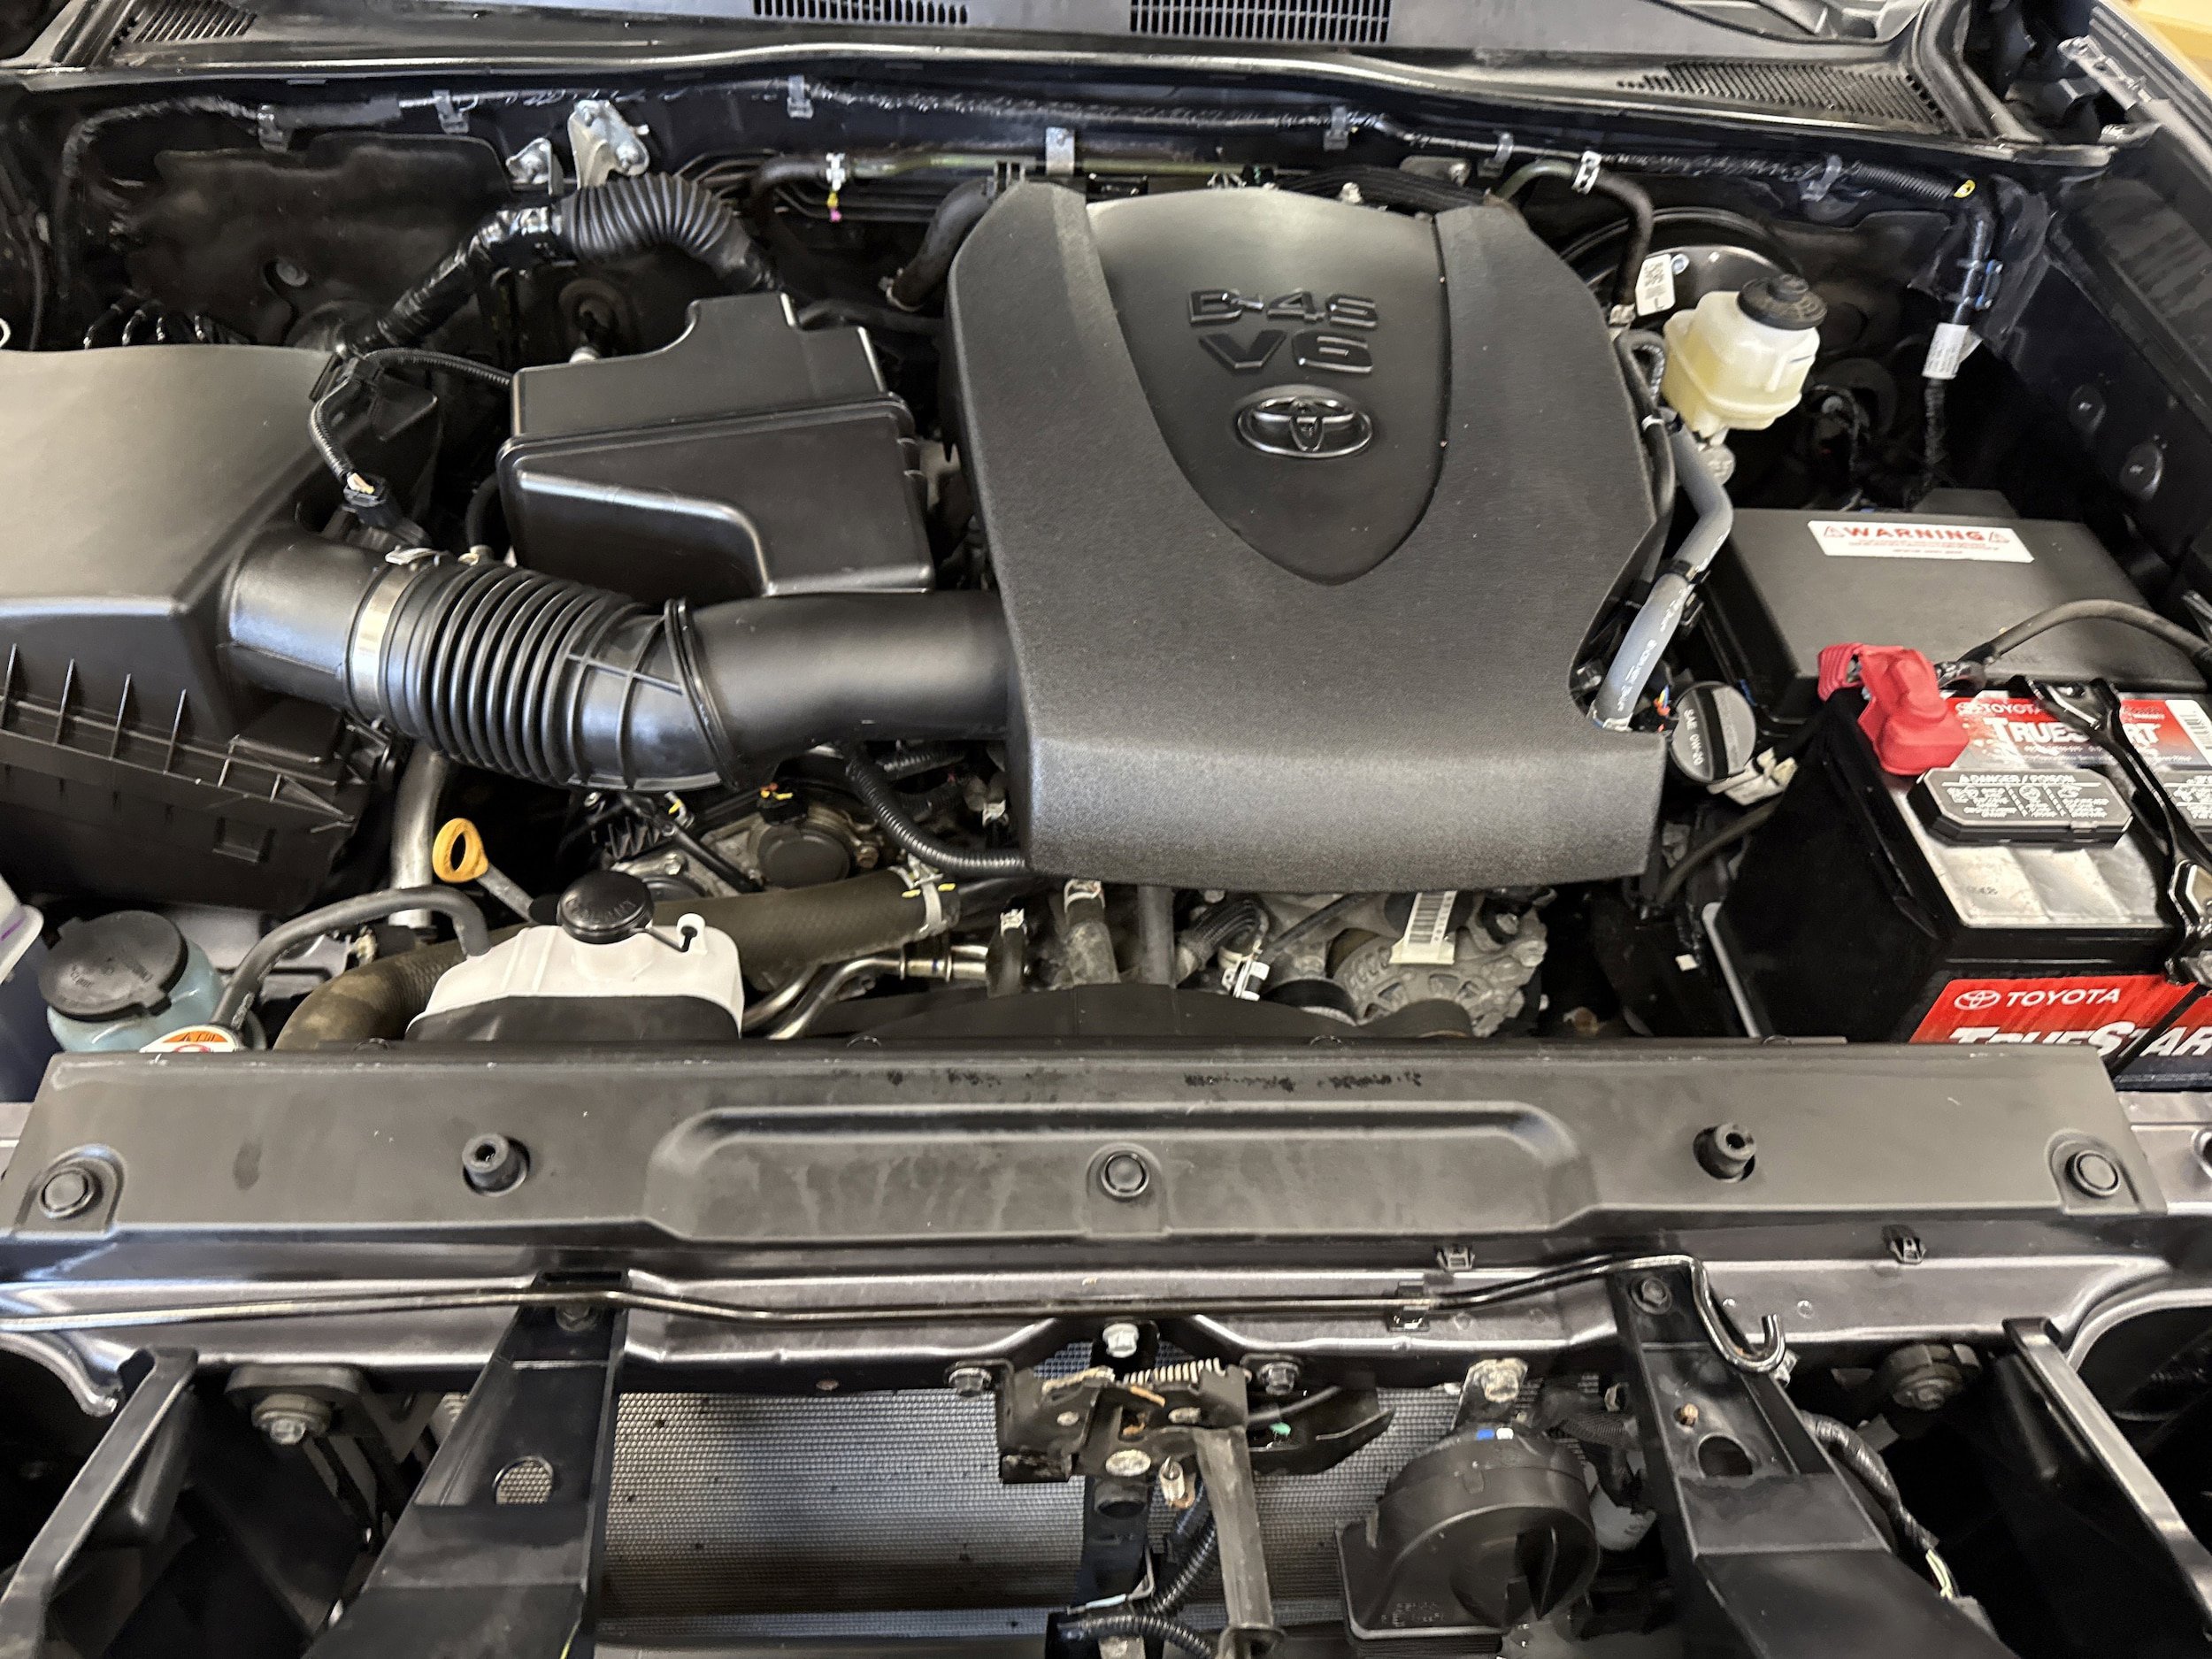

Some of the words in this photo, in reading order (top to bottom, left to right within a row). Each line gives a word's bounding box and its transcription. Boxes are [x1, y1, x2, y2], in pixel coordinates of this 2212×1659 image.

[1188, 288, 1379, 329] D-4S
[1199, 329, 1374, 374] V6
[1844, 526, 1985, 541] WARNING
[1683, 708, 1698, 731] SAE
[2005, 987, 2122, 1007] TOYOTA
